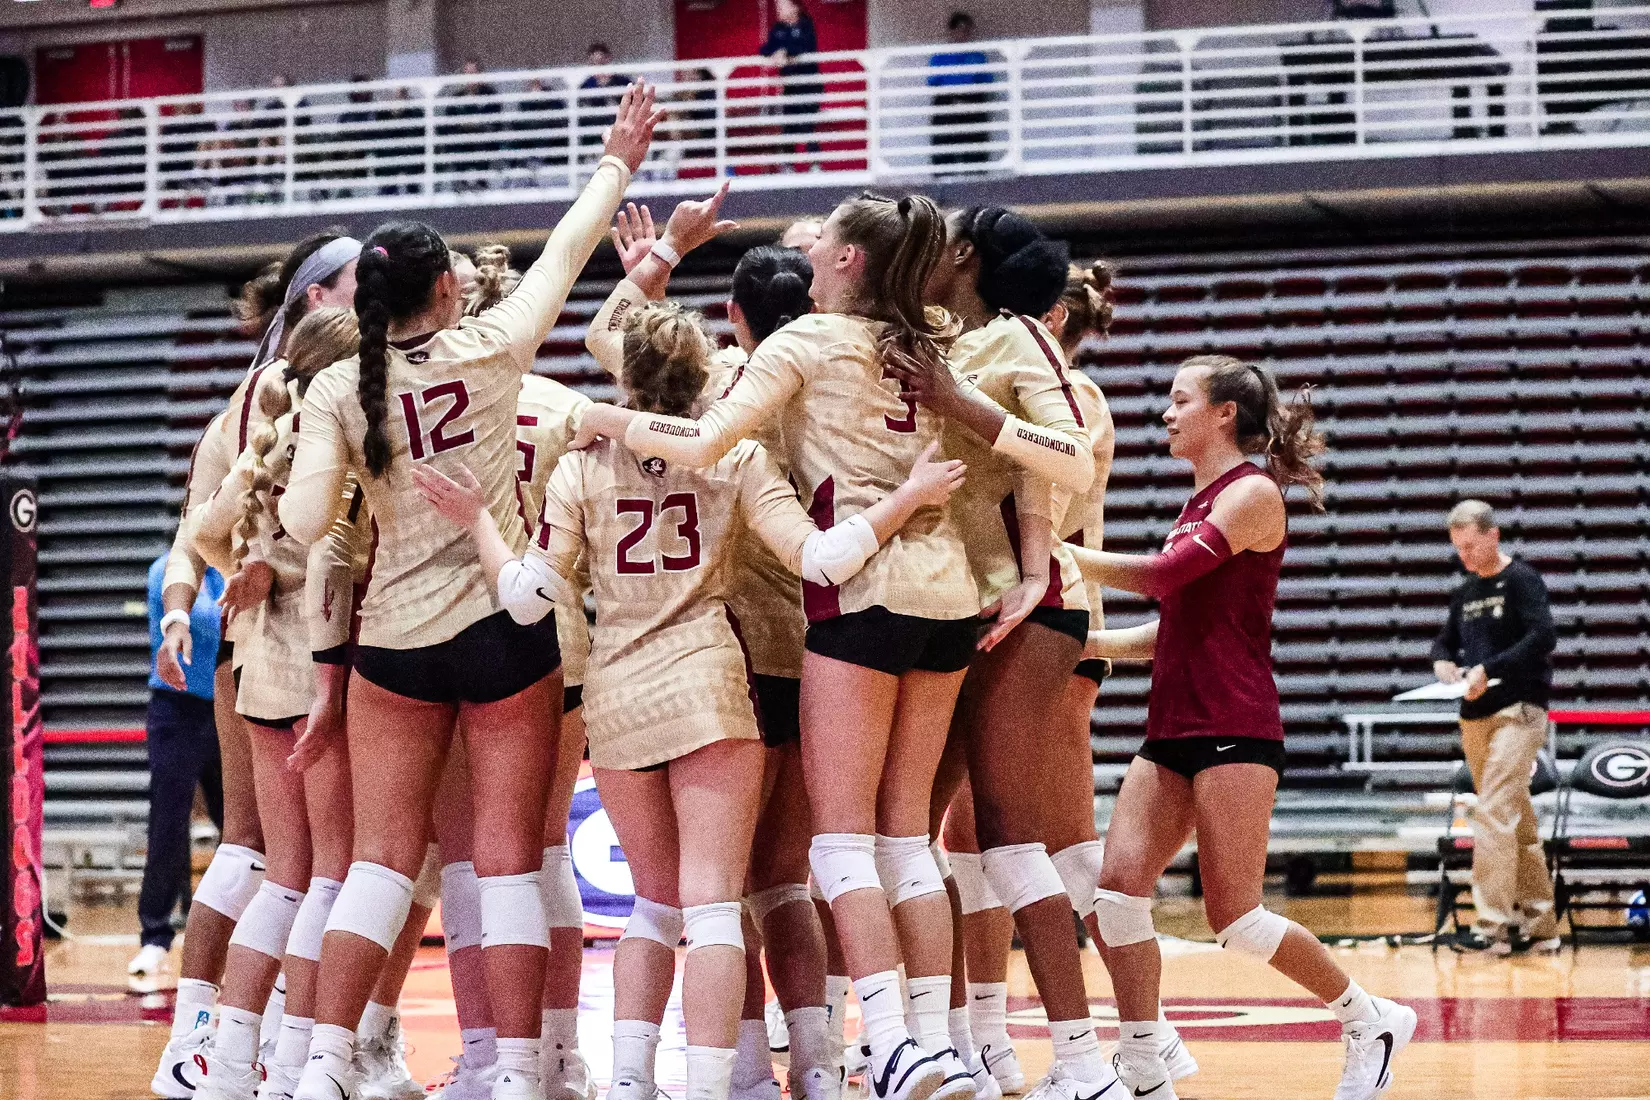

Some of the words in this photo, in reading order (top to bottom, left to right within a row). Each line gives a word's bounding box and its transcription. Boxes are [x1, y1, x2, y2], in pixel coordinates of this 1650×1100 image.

[397, 379, 475, 461] 12
[648, 420, 701, 438] NCONQUERED
[1016, 428, 1076, 457] UNCONQUERED
[615, 491, 702, 576] 23
